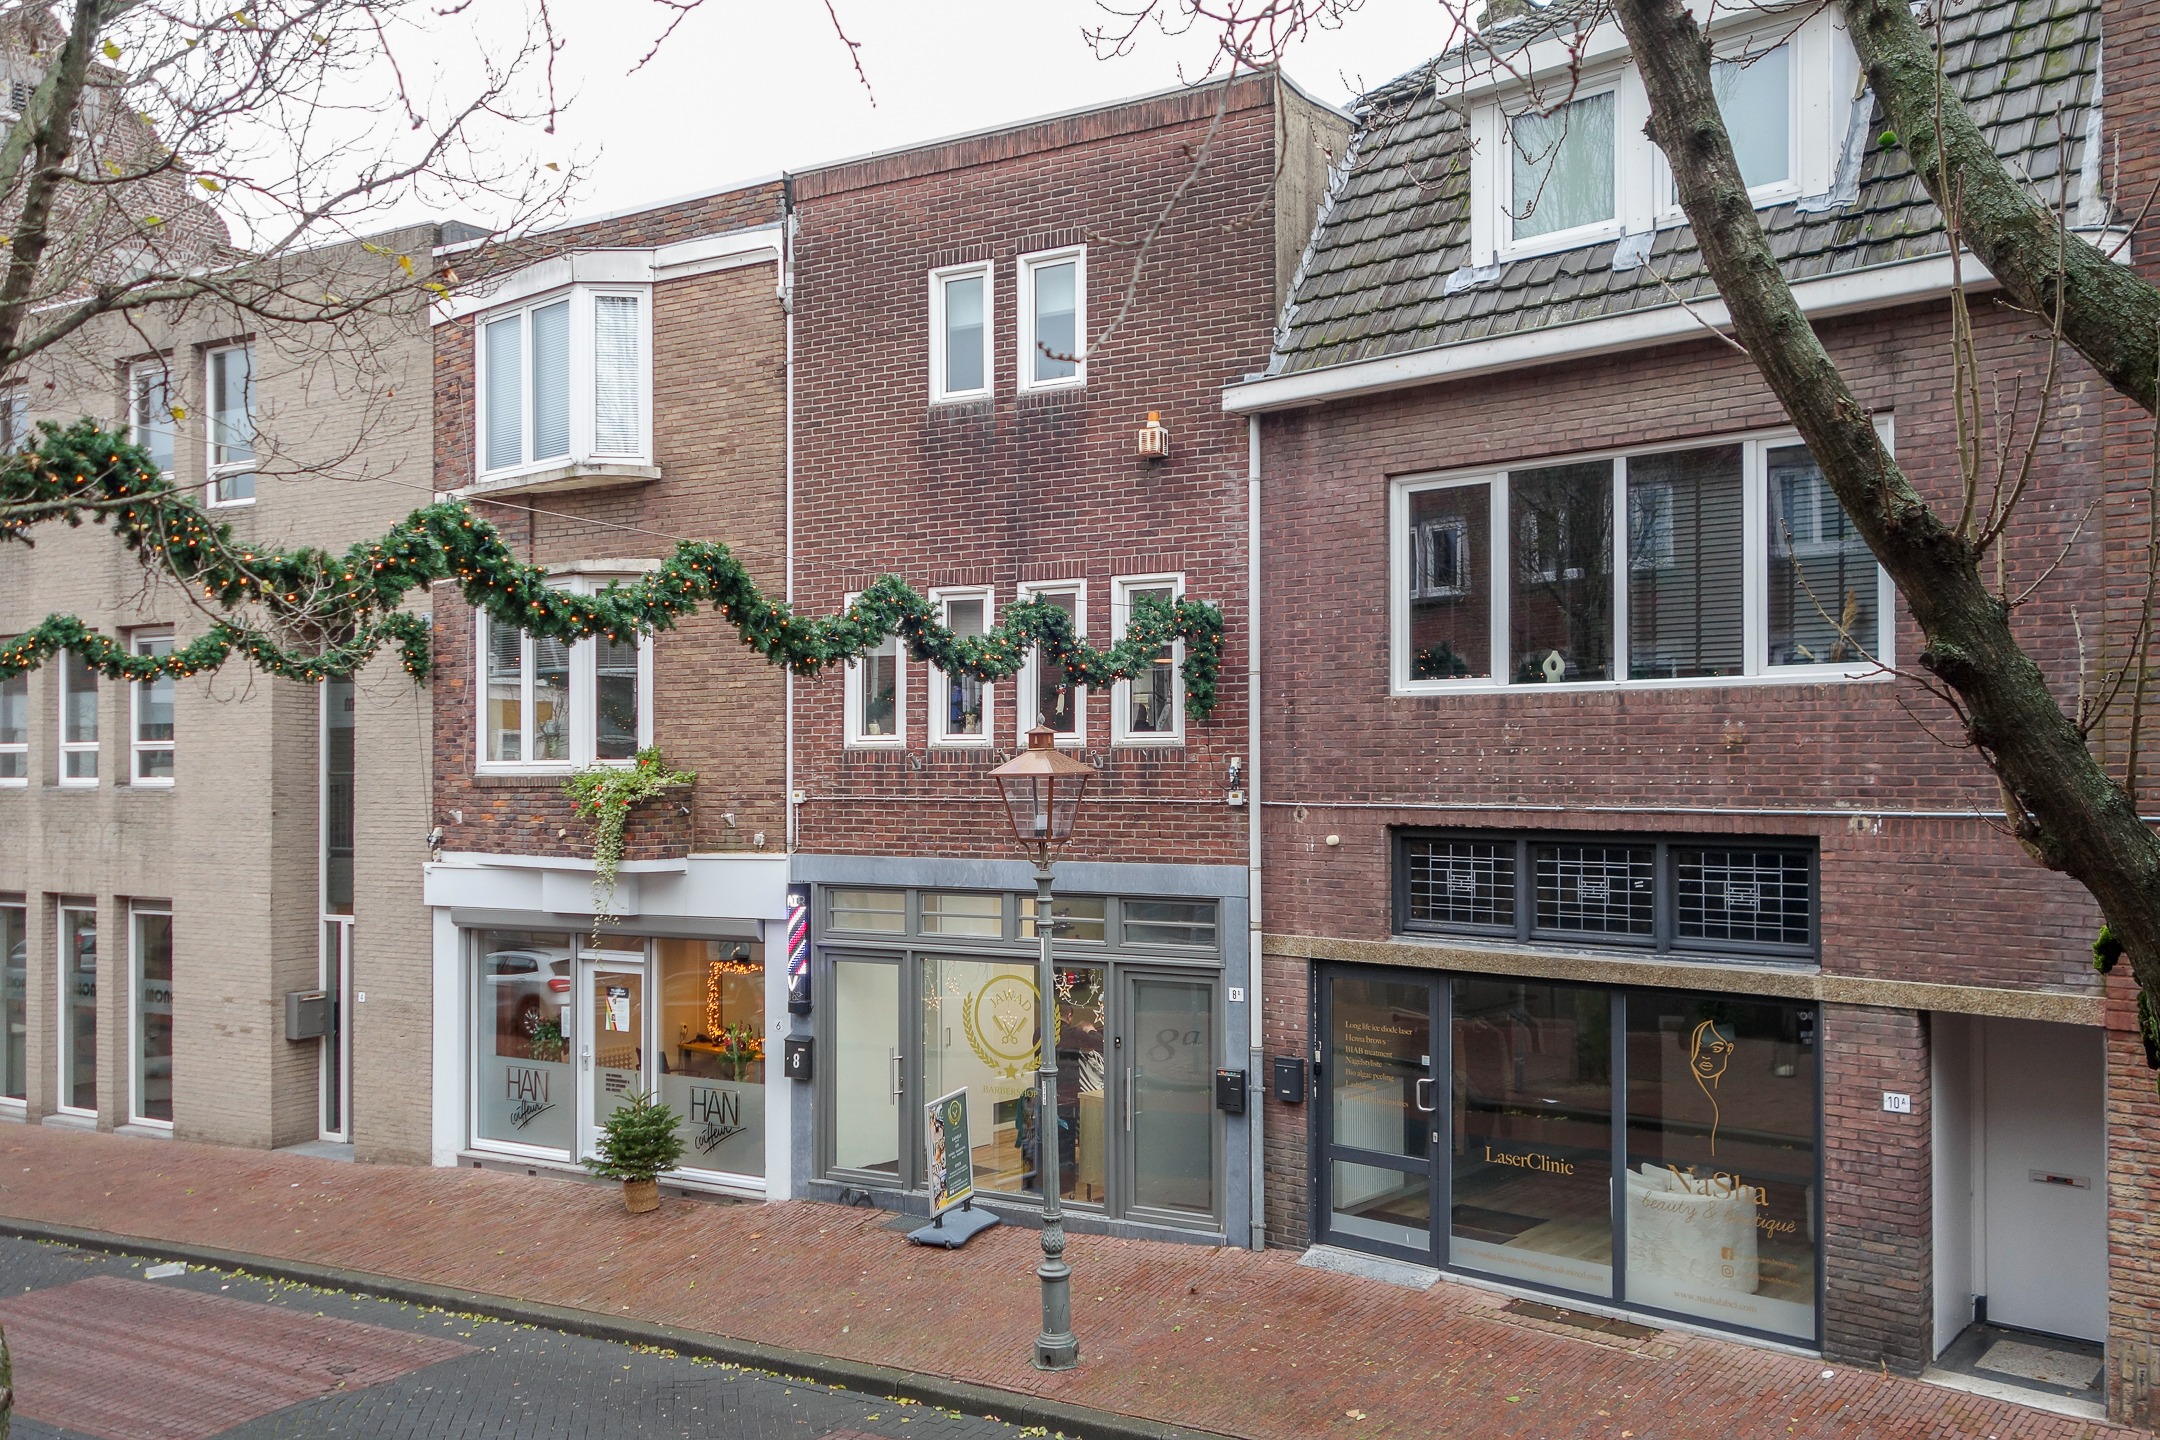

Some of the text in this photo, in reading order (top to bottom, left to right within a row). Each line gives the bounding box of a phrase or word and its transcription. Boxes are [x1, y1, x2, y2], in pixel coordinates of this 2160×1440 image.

[990, 989, 1032, 1012] JAWAD
[775, 1021, 781, 1031] 6
[1345, 1020, 1361, 1032] Long
[1362, 1022, 1371, 1031] life
[1380, 1025, 1398, 1034] diode
[1398, 1027, 1413, 1036] laser
[1345, 1033, 1387, 1045] Henna brows
[793, 1053, 800, 1069] 8
[1345, 1045, 1393, 1058] BIAB treatment
[507, 1067, 548, 1103] HAN
[1345, 1068, 1395, 1082] Bio algae peeling
[982, 1085, 1039, 1099] BARBERSHOP
[510, 1099, 550, 1129] coiffeur
[691, 1088, 738, 1126] HAN
[695, 1121, 740, 1153] coiffeur
[1484, 1145, 1574, 1175] LaserClinic
[1666, 1163, 1770, 1207] NaSha
[1640, 1189, 1697, 1223] beauty
[1702, 1200, 1717, 1218] &
[1673, 1290, 1757, 1313] www.nashalabel.com
